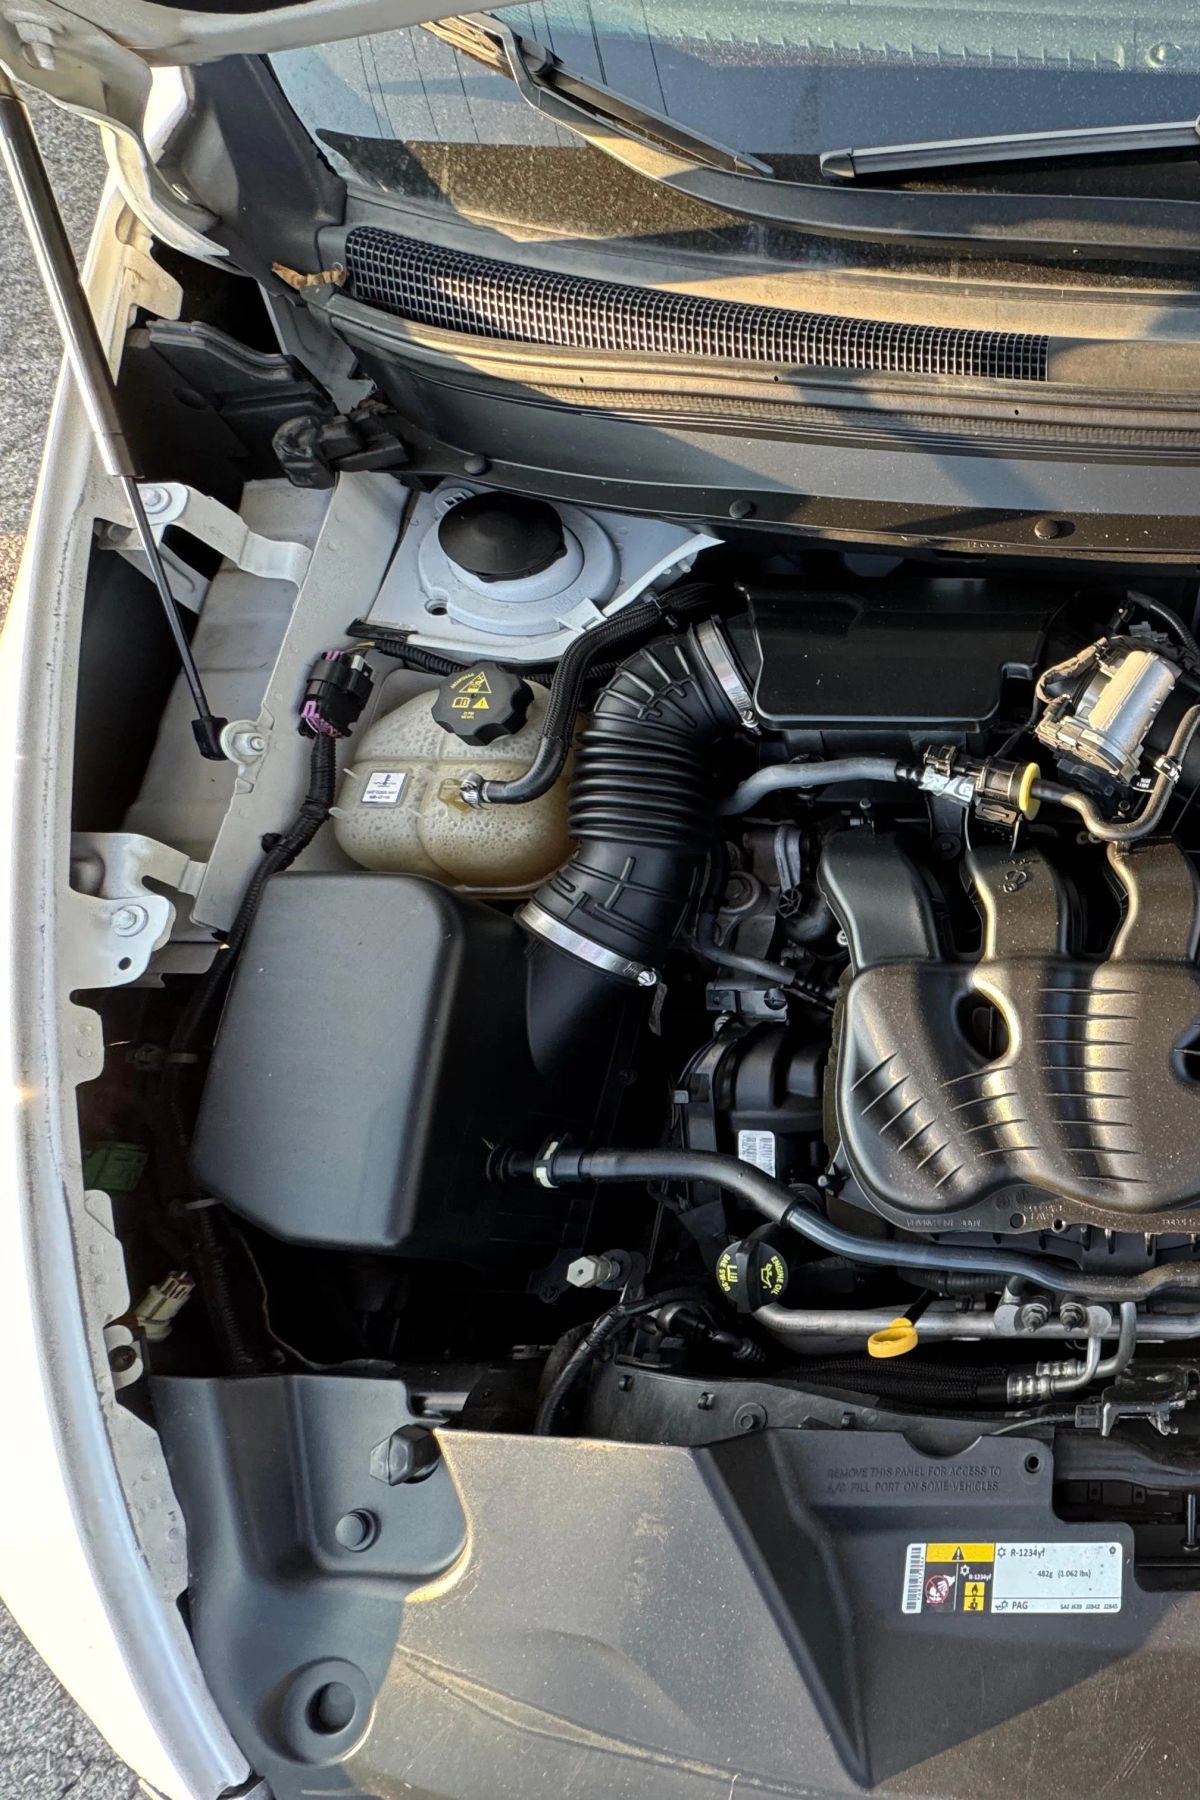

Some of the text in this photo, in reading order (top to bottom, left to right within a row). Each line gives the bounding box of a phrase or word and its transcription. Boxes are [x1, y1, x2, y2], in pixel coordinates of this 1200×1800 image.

[770, 1255, 785, 1295] ENGINE OIL
[827, 1464, 1001, 1479] REMOVE THIS PANEL FOR ACCESS TO
[875, 1481, 900, 1493] PORT
[903, 1481, 918, 1493] ON
[920, 1481, 949, 1492] SOME
[951, 1480, 999, 1492] VEHICLES
[1010, 1547, 1046, 1559] R-1234yf
[1037, 1569, 1092, 1579] 482g (1.062 lbs)
[1011, 1601, 1029, 1610] PAG
